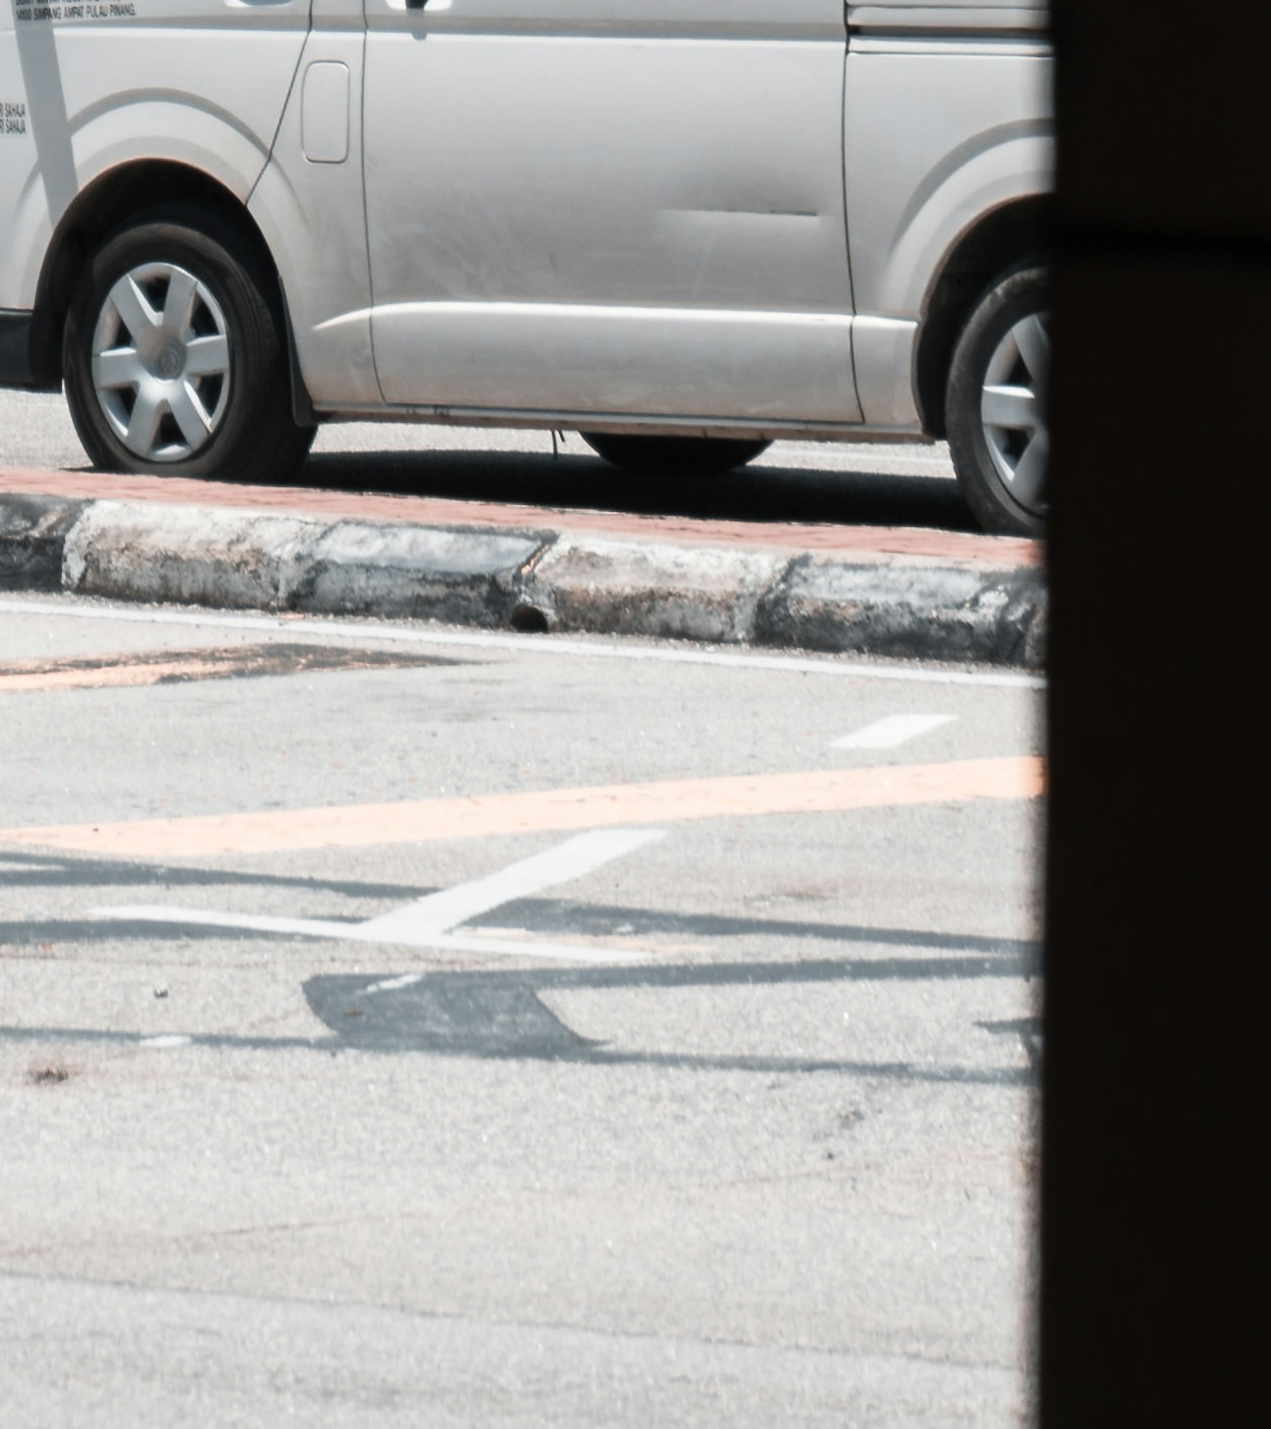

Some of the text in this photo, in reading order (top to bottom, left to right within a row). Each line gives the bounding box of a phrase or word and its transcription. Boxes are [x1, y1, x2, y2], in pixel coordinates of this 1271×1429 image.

[34, 6, 62, 21] SIMPANG
[86, 4, 109, 18] PULAU
[5, 102, 26, 118] SAHAJA
[5, 118, 26, 135] SAHAJA
